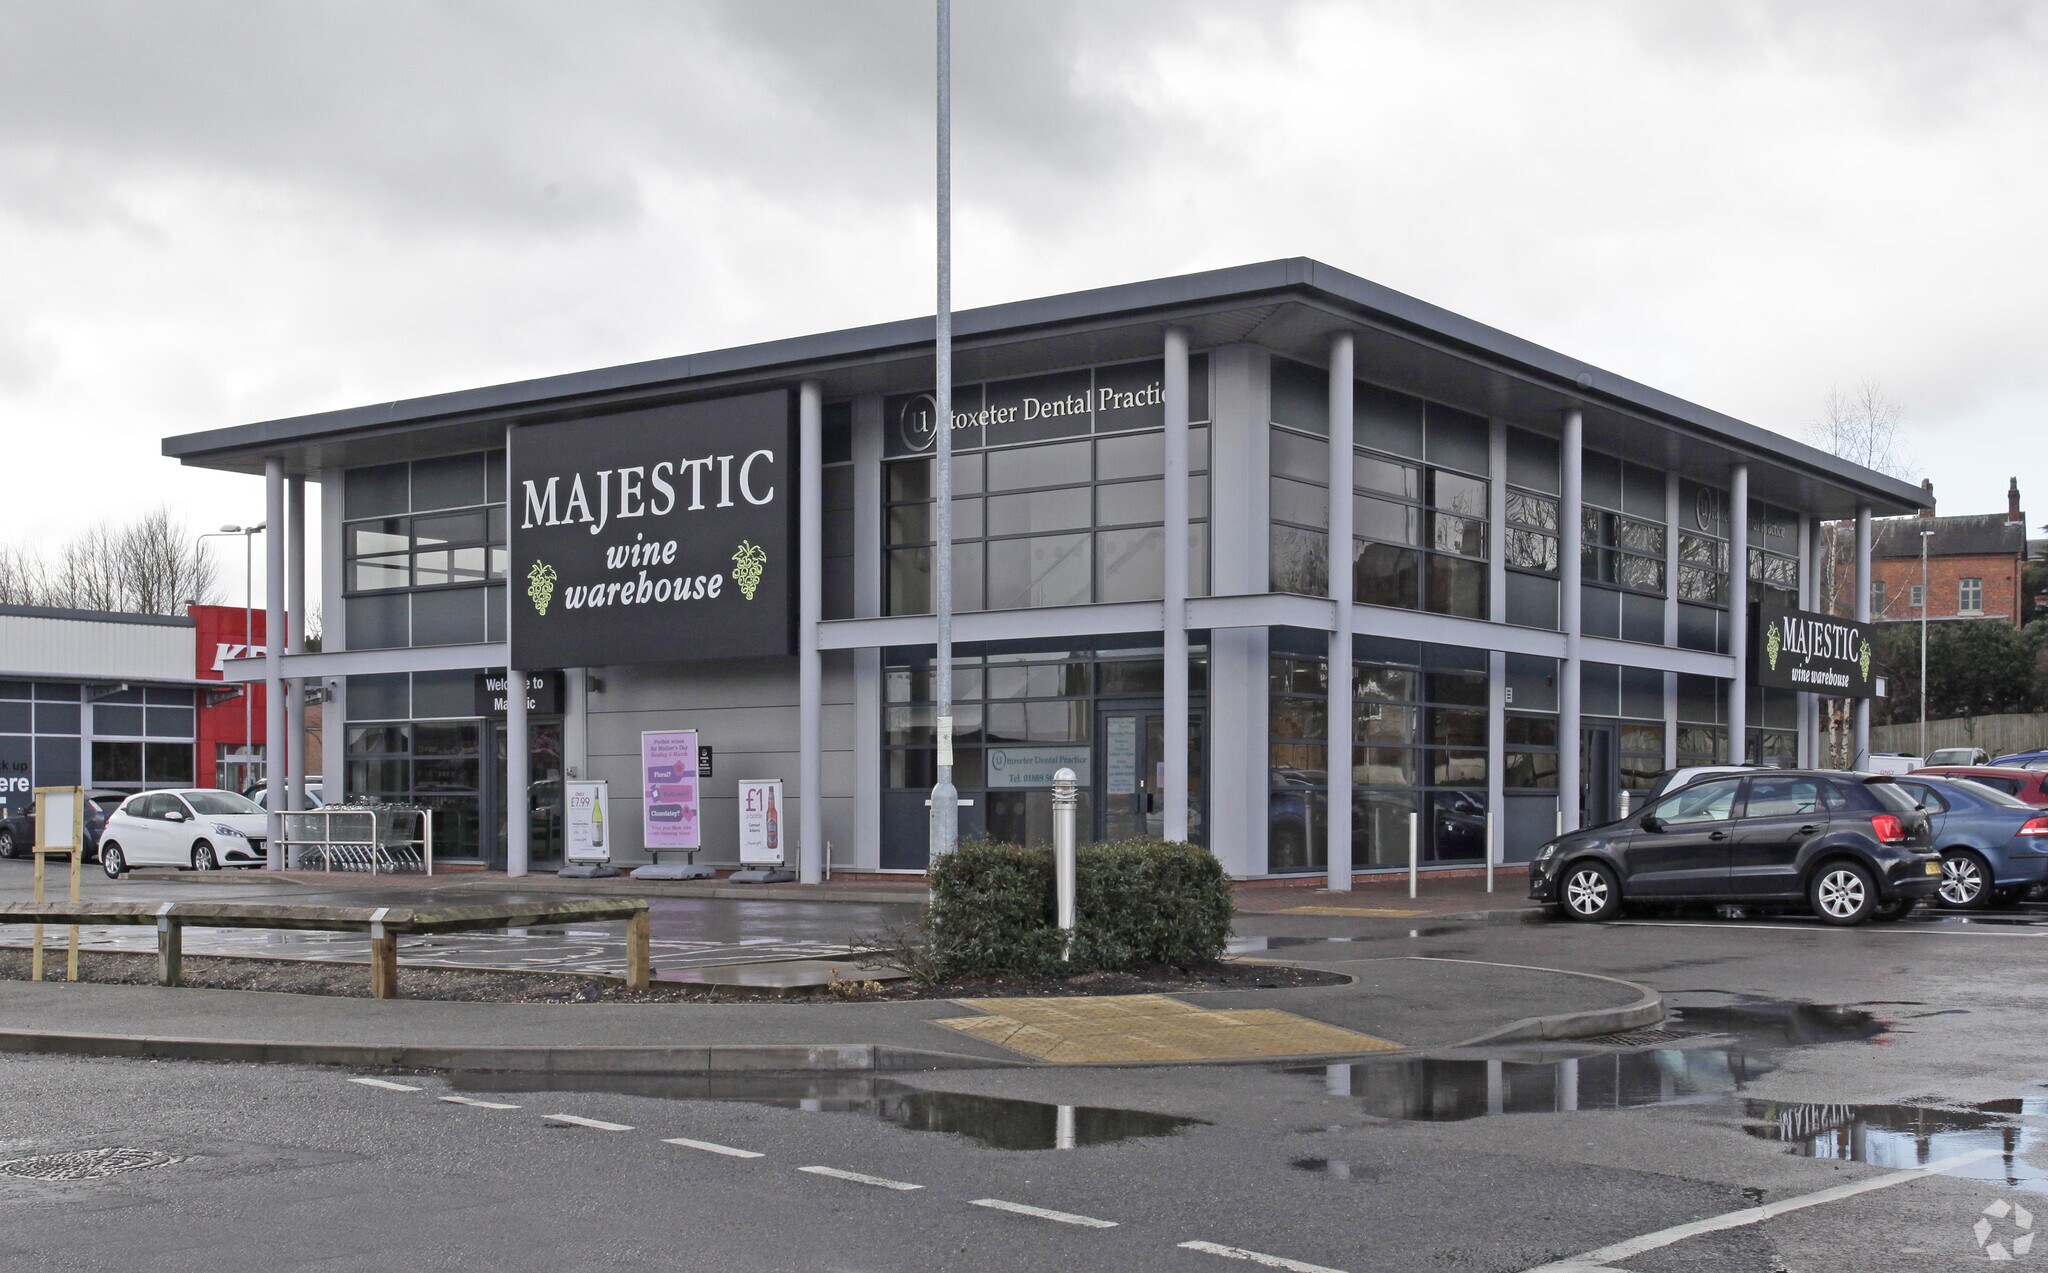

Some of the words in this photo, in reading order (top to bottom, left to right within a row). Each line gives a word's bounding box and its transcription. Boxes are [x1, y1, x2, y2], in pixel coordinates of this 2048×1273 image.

[1023, 389, 1092, 421] Dental
[1098, 381, 1166, 412] Practi
[521, 449, 774, 535] MAJESTIC
[606, 532, 678, 569] wine
[564, 570, 723, 609] warehouse
[1782, 616, 1859, 664] MAJESTIC
[486, 677, 531, 691] Welce
[533, 676, 544, 689] to
[1791, 662, 1810, 683] wine
[1811, 667, 1850, 688] warehouse
[494, 697, 536, 711] Maic
[12, 763, 28, 774] up
[1034, 755, 1059, 764] Dental
[1059, 754, 1088, 764] Practice
[570, 796, 591, 808] £7.99
[745, 787, 763, 812] £1
